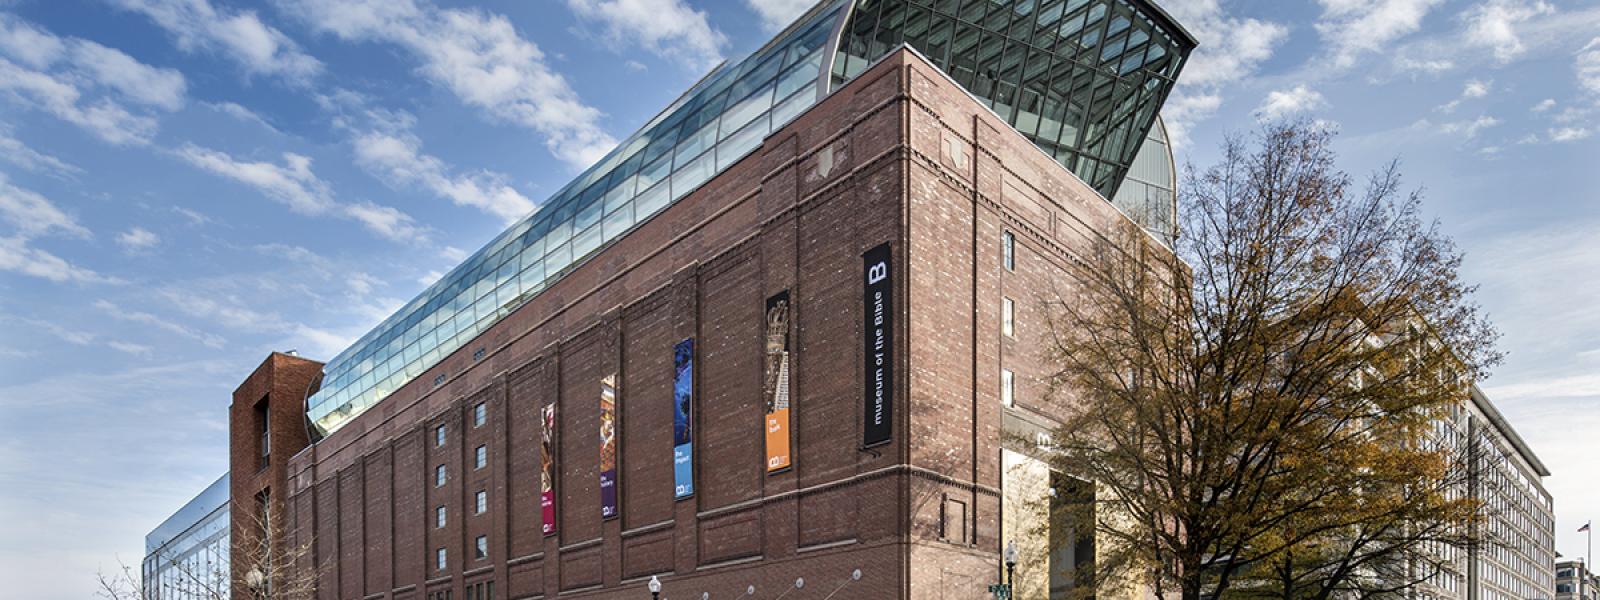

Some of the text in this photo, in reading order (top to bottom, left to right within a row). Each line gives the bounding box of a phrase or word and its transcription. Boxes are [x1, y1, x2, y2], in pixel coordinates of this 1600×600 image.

[868, 261, 887, 285] B
[874, 291, 884, 425] museum of the Bible
